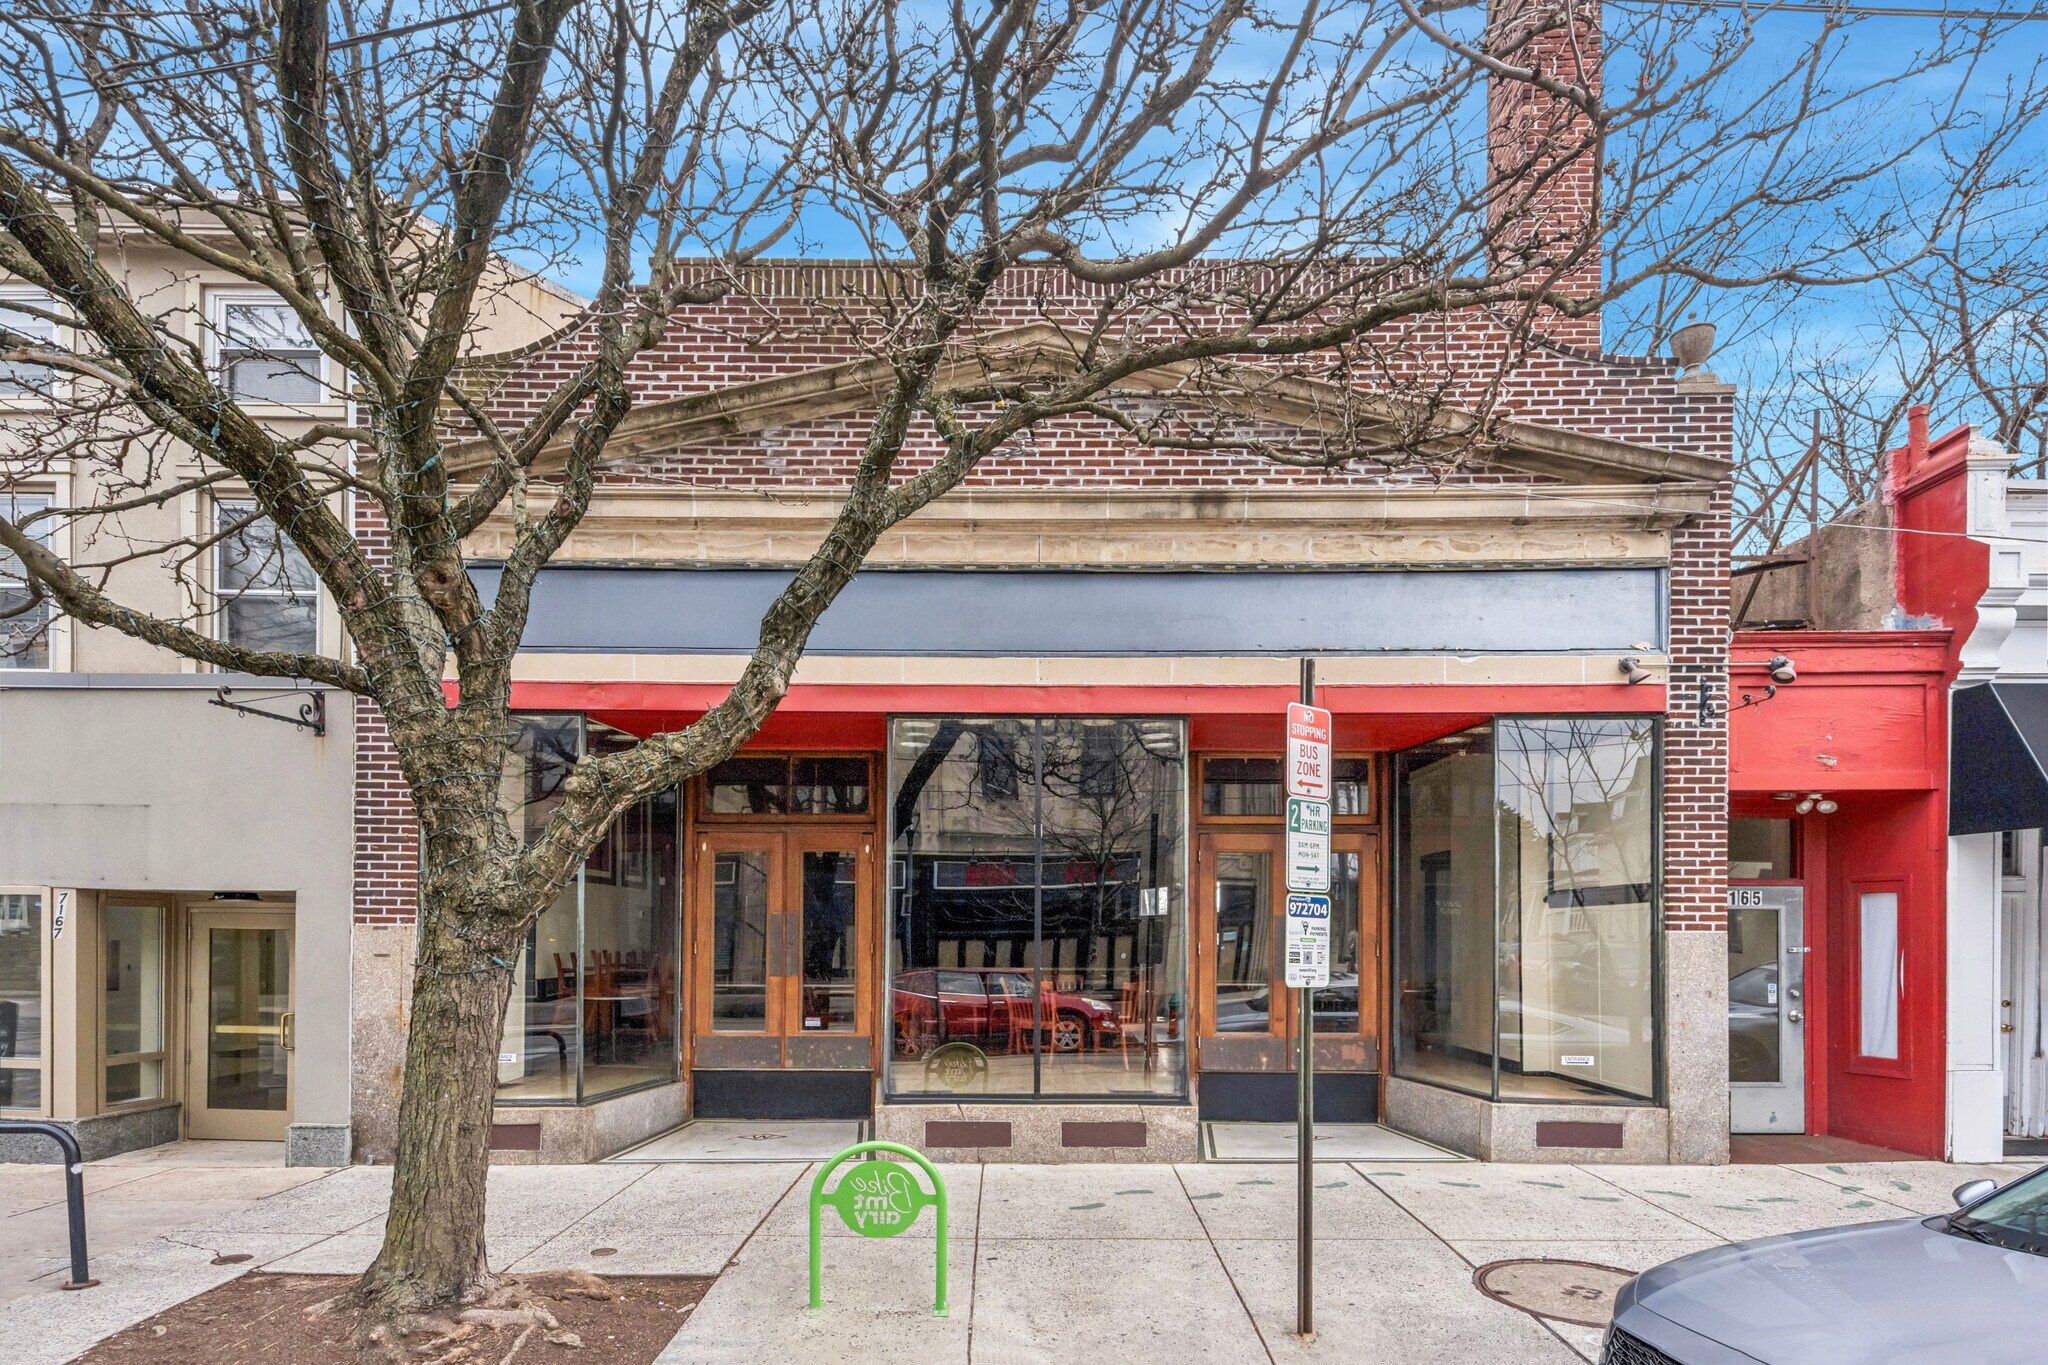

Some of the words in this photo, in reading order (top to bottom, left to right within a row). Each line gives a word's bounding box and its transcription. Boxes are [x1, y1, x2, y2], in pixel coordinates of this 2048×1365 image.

[1304, 709, 1314, 724] NO
[1292, 723, 1326, 740] STOPPING
[1300, 744, 1318, 760] BUS
[1297, 761, 1321, 778] ZONE
[1291, 804, 1299, 827] 2
[1309, 805, 1321, 818] HR
[1301, 818, 1328, 832] PARKING
[54, 892, 68, 939] 7167
[1289, 901, 1328, 916] 972704
